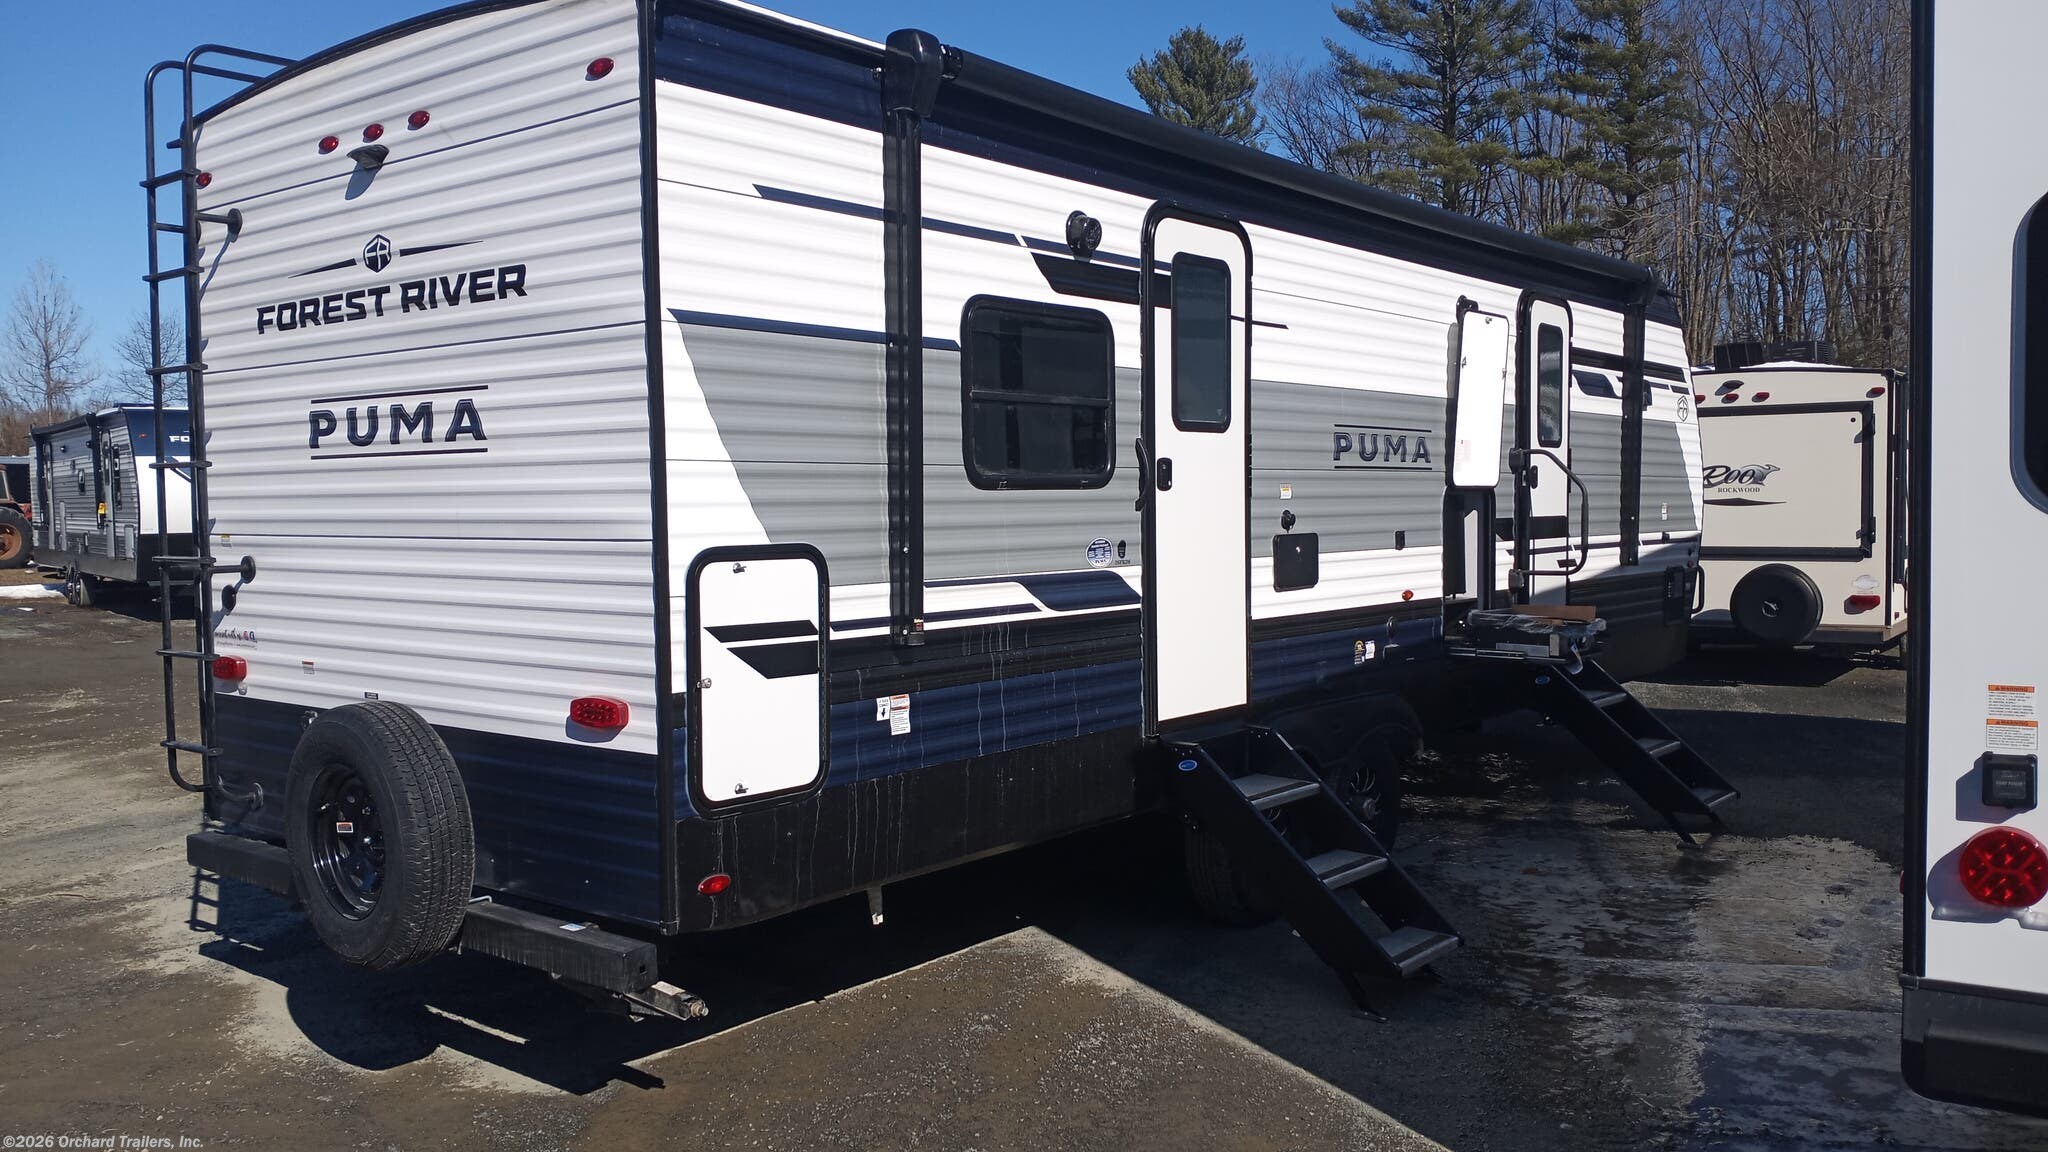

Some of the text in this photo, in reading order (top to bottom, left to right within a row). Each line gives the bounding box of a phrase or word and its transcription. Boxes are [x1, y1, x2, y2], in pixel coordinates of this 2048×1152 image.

[256, 263, 528, 335] FOREST RIVER
[308, 398, 488, 449] PUMA
[1333, 431, 1432, 463] PUMA
